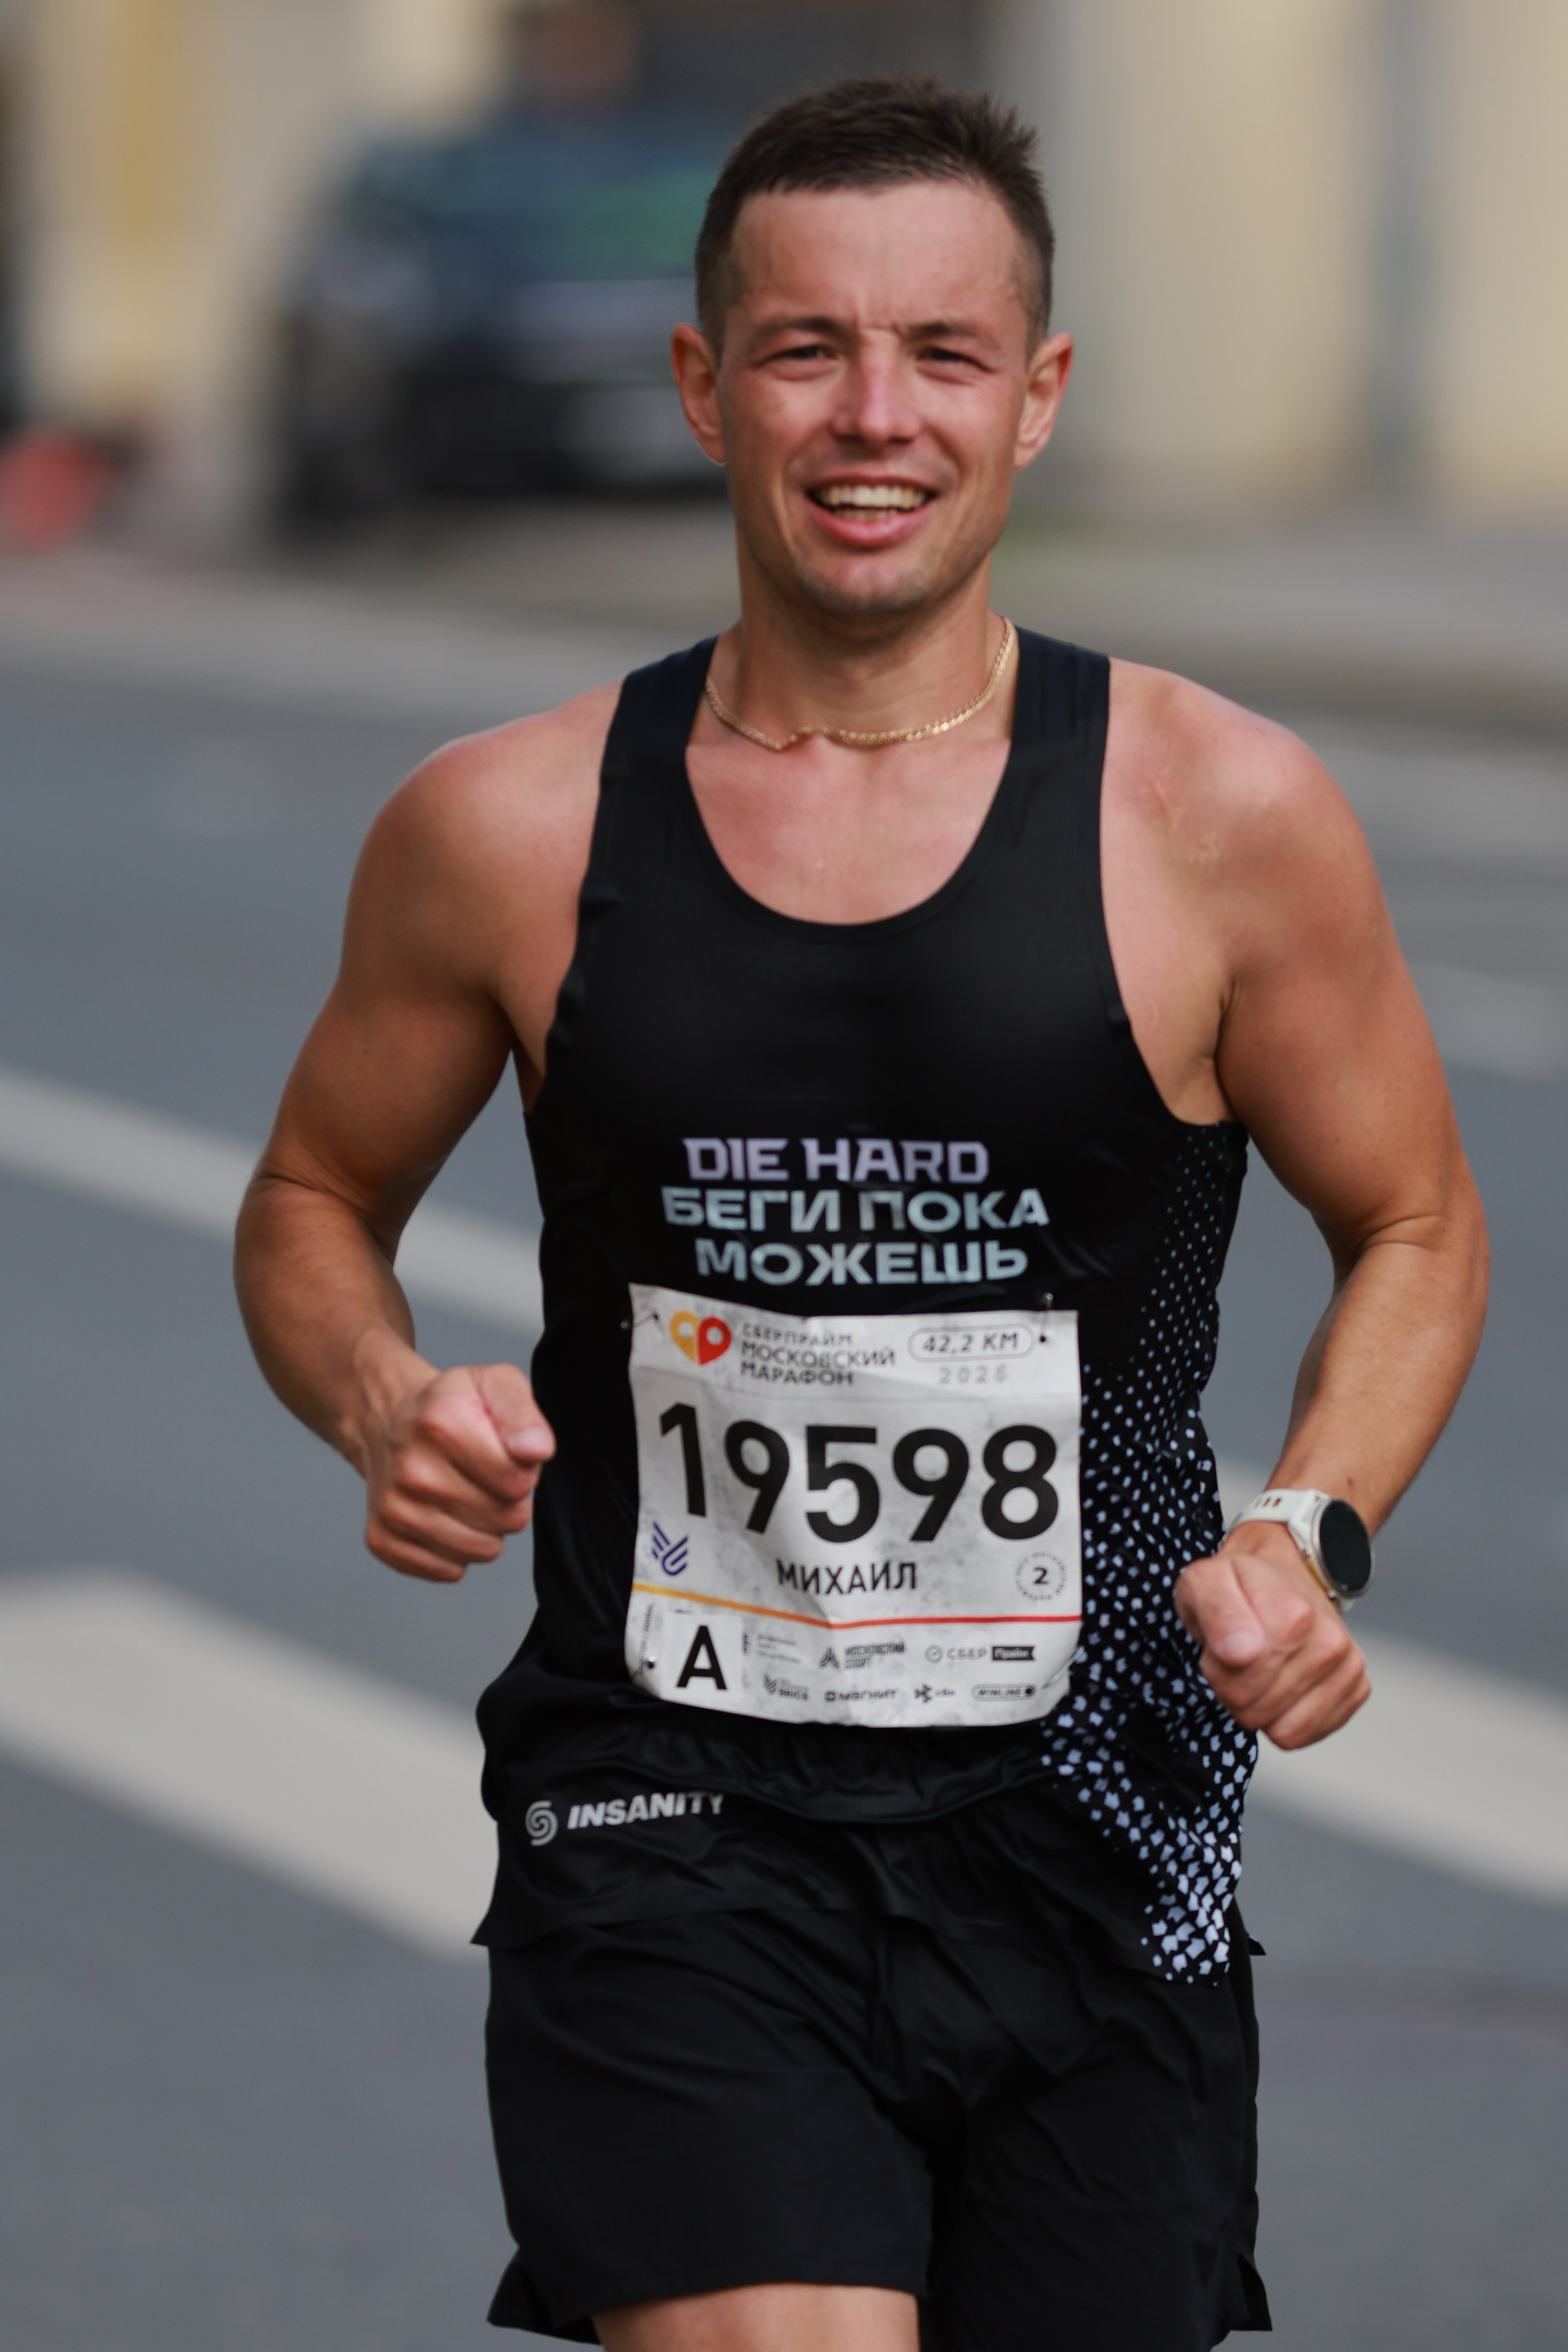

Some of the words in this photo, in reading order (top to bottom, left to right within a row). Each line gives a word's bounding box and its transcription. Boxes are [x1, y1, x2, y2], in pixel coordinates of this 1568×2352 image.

[684, 1138, 789, 1180] DIE
[801, 1137, 989, 1183] HARD
[661, 1186, 840, 1232] БЕГИ
[859, 1188, 1050, 1232] ПОКА
[695, 1238, 1028, 1285] МОЖЕШЬ
[742, 1322, 853, 1346] СБЕРПРАЙМ
[923, 1333, 973, 1354] 42,2
[741, 1341, 895, 1369] МОСКОВСКИЙ
[741, 1362, 854, 1386] МАРАФОН
[939, 1363, 1008, 1384] 2026
[660, 1402, 1059, 1543] 19598
[776, 1559, 916, 1594] МИХАИЛ
[1033, 1567, 1049, 1585] 2
[676, 1626, 727, 1691] A
[567, 1792, 724, 1830] INSANITY
